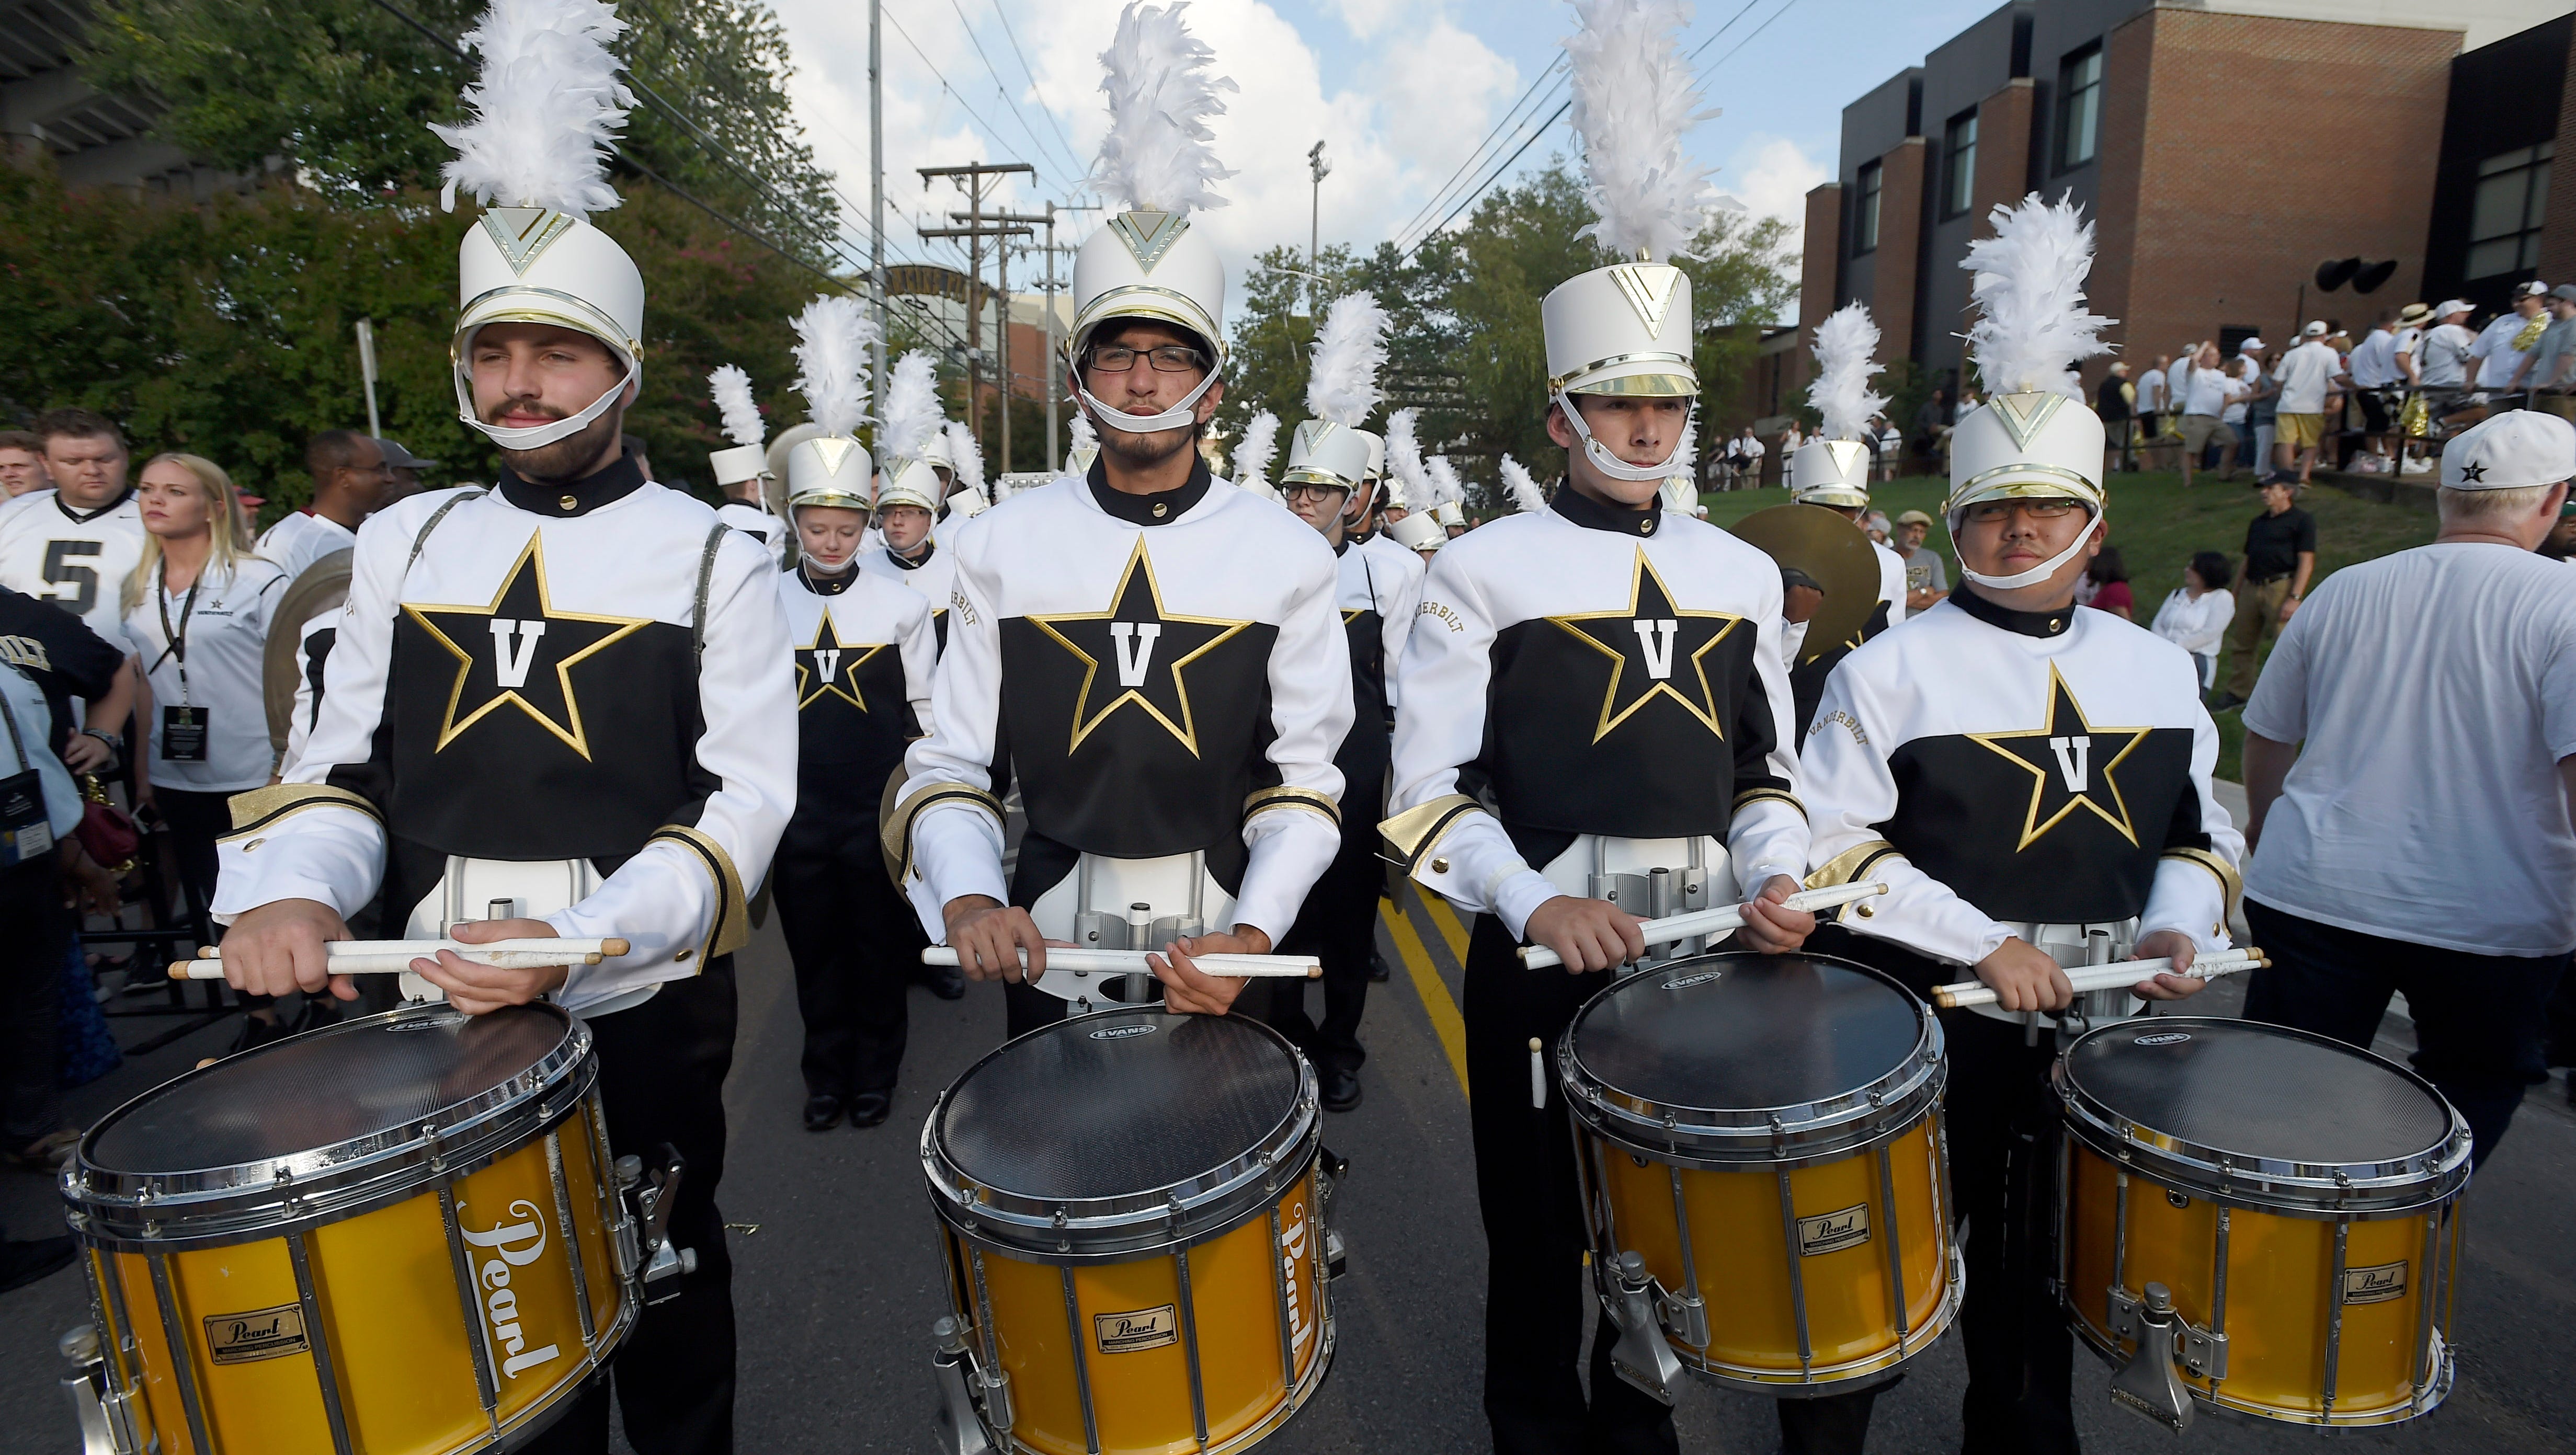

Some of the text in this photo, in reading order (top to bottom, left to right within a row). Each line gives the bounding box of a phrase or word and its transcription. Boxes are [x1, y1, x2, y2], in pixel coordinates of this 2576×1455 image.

[40, 539, 104, 616] 5
[488, 618, 546, 688] V
[1110, 622, 1161, 687] V
[1633, 619, 1678, 680] V
[814, 649, 840, 683] V
[1809, 711, 1868, 744] VANDERBILT
[2049, 736, 2091, 793] V
[1668, 973, 1715, 988] EVANS
[1098, 1027, 1148, 1037] EVANS
[2140, 1035, 2185, 1044] EVANS
[1813, 1216, 1853, 1240] Pearl
[456, 1199, 560, 1380] Pearl
[1281, 1202, 1312, 1355] Pearl
[2356, 1271, 2395, 1290] Pearl
[224, 1317, 279, 1344] Pearl
[1111, 1317, 1157, 1337] Pearl
[1135, 1332, 1168, 1343] PERCUSSION
[222, 1337, 296, 1353] MARCHING PERCUSSION
